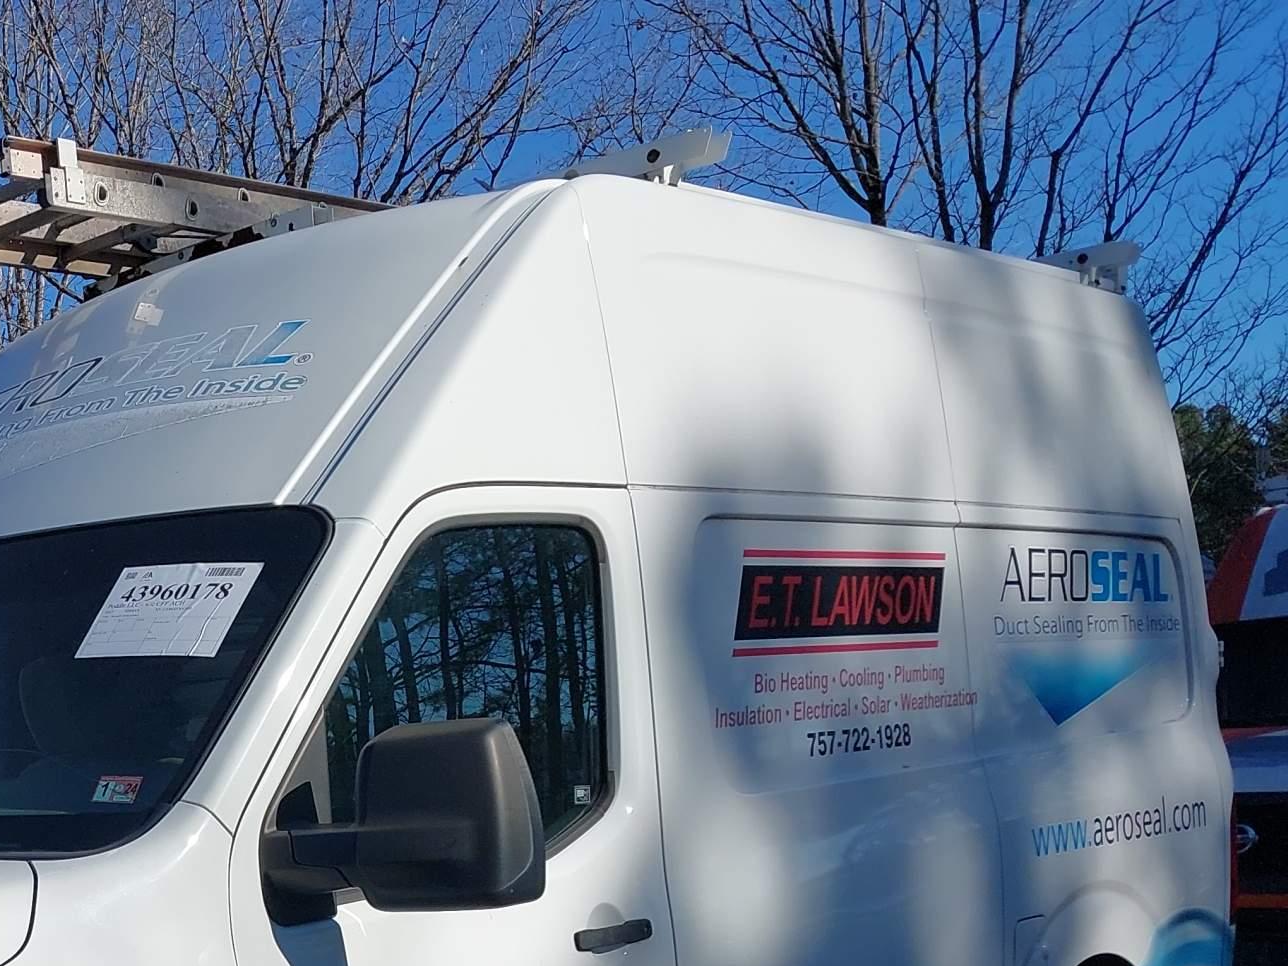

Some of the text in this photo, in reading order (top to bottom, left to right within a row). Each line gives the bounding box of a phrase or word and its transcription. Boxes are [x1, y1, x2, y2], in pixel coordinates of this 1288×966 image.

[121, 383, 184, 409] The
[186, 371, 308, 399] Inside
[120, 582, 234, 603] 43960178
[748, 575, 936, 628] E.T. LAWSON
[994, 615, 1181, 639] Duct Sealing From The Inside
[754, 663, 945, 694] Bio Heating Cooling Plumbing
[715, 688, 978, 728] Insulation Electrical Solar Weatherization
[807, 723, 911, 757] 757-722-1928
[1031, 795, 1207, 857] www.aeroseal.com
